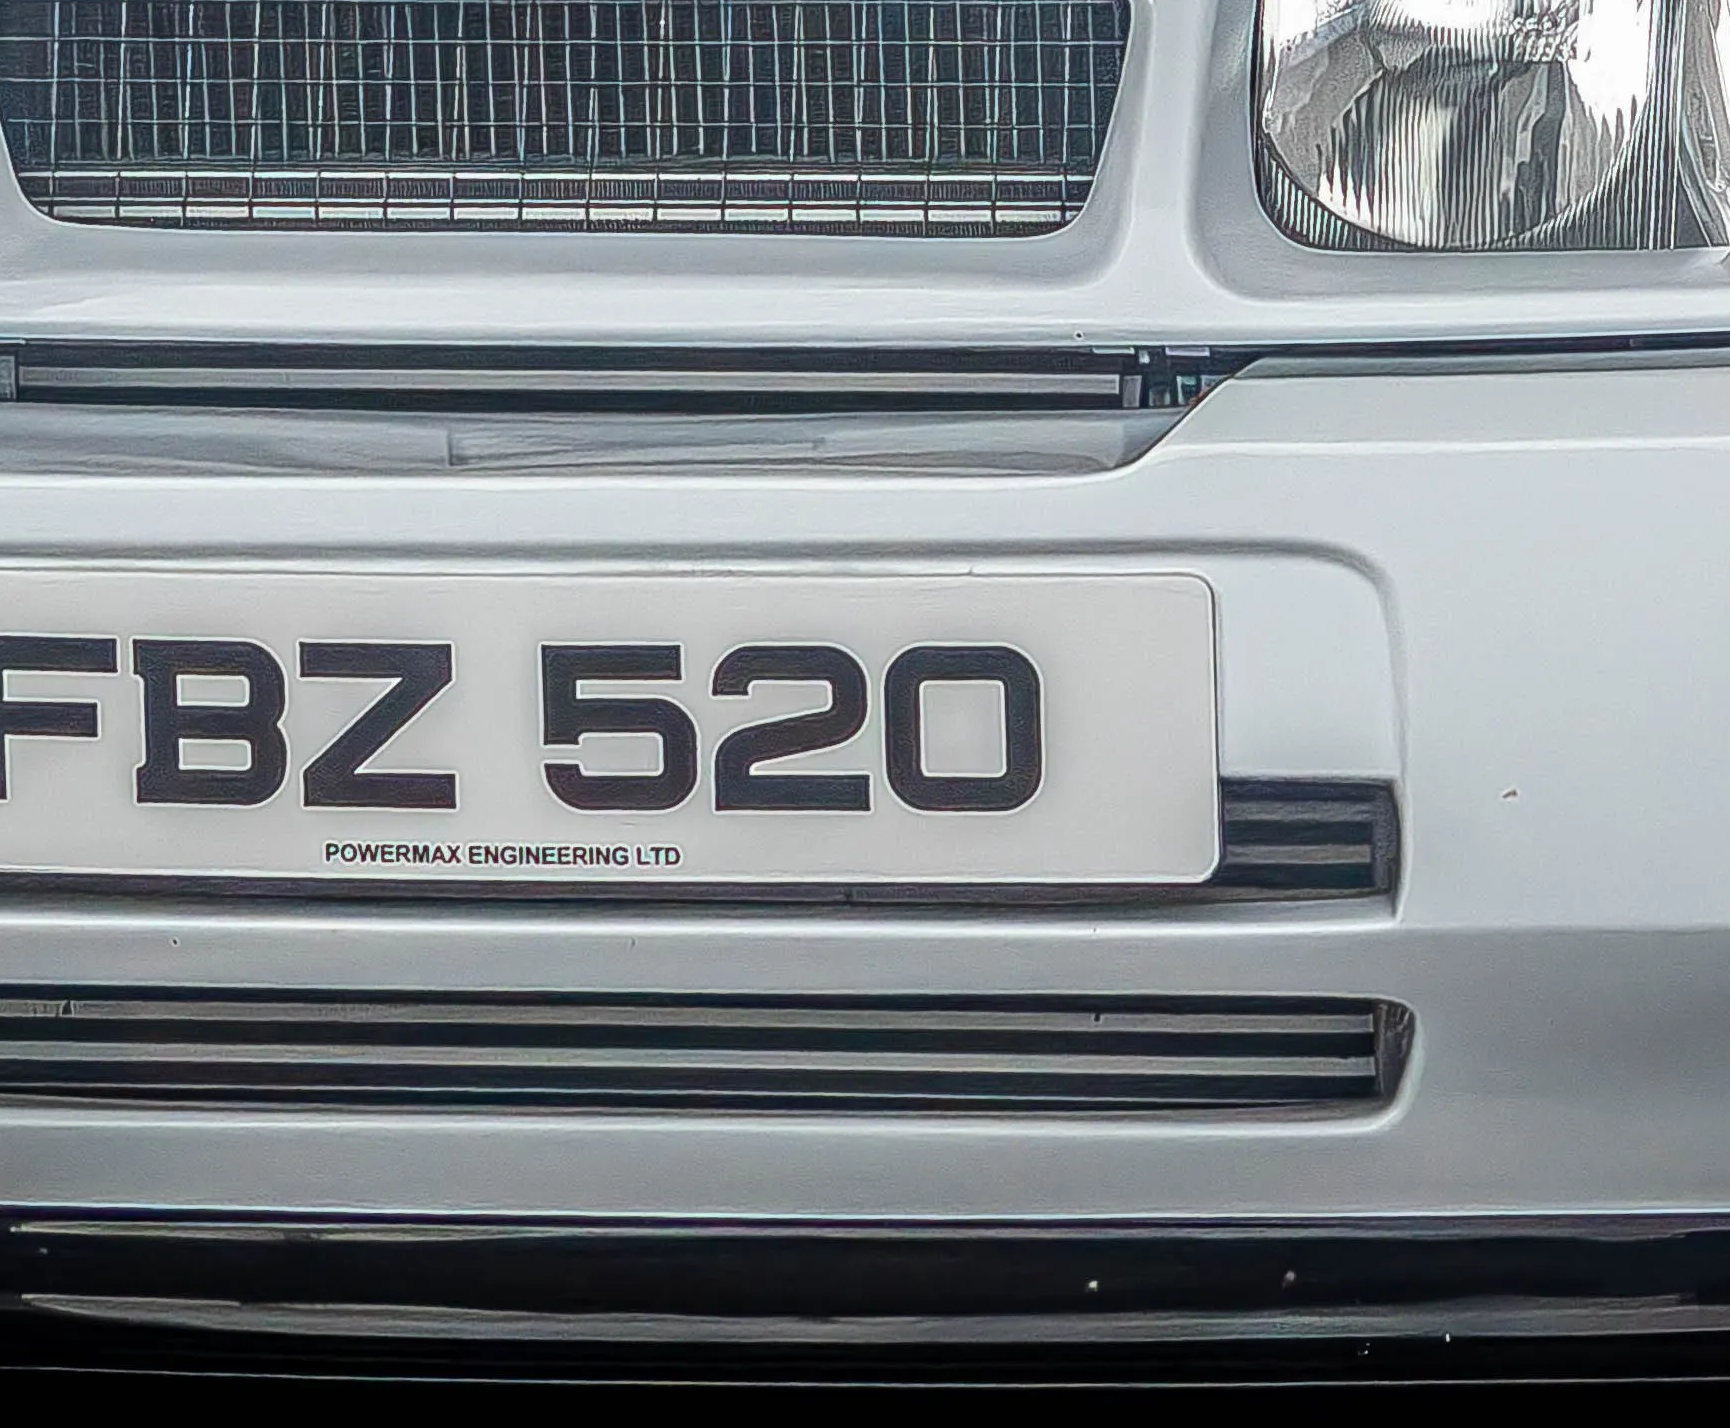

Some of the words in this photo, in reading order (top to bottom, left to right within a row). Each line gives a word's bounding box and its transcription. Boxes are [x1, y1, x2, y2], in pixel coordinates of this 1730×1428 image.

[539, 643, 1044, 813] 520
[325, 843, 462, 864] POWERMAX
[468, 845, 629, 866] ENGINEERING
[636, 846, 681, 866] LTD
